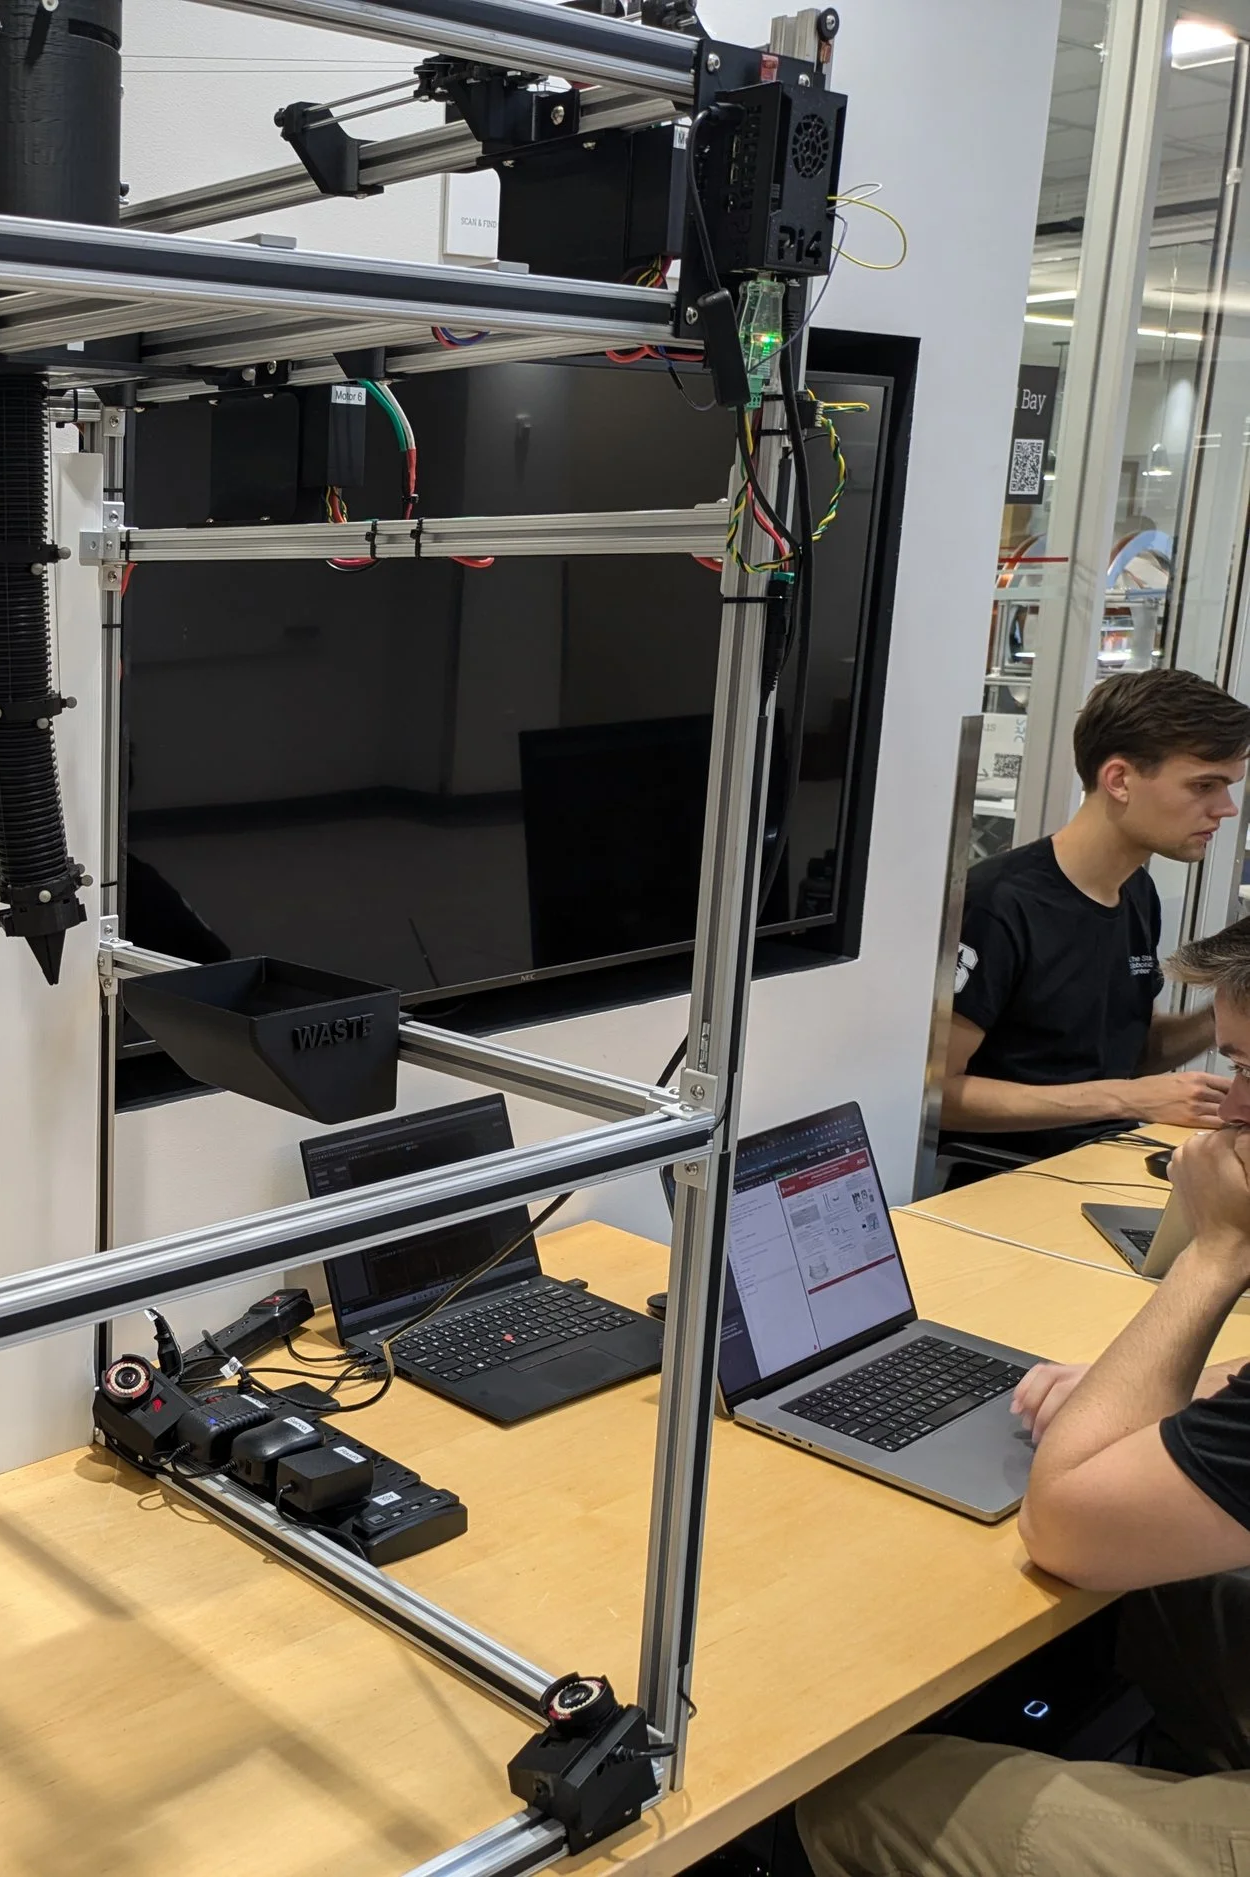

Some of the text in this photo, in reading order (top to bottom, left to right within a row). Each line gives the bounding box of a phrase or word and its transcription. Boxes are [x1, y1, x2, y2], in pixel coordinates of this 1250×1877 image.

[460, 216, 477, 226] SCAN
[482, 219, 497, 229] FIND
[777, 225, 823, 265] Pi4
[336, 390, 363, 402] Motor 6
[1021, 389, 1047, 415] Bay
[520, 973, 536, 982] NEC
[293, 1013, 375, 1052] WASTE
